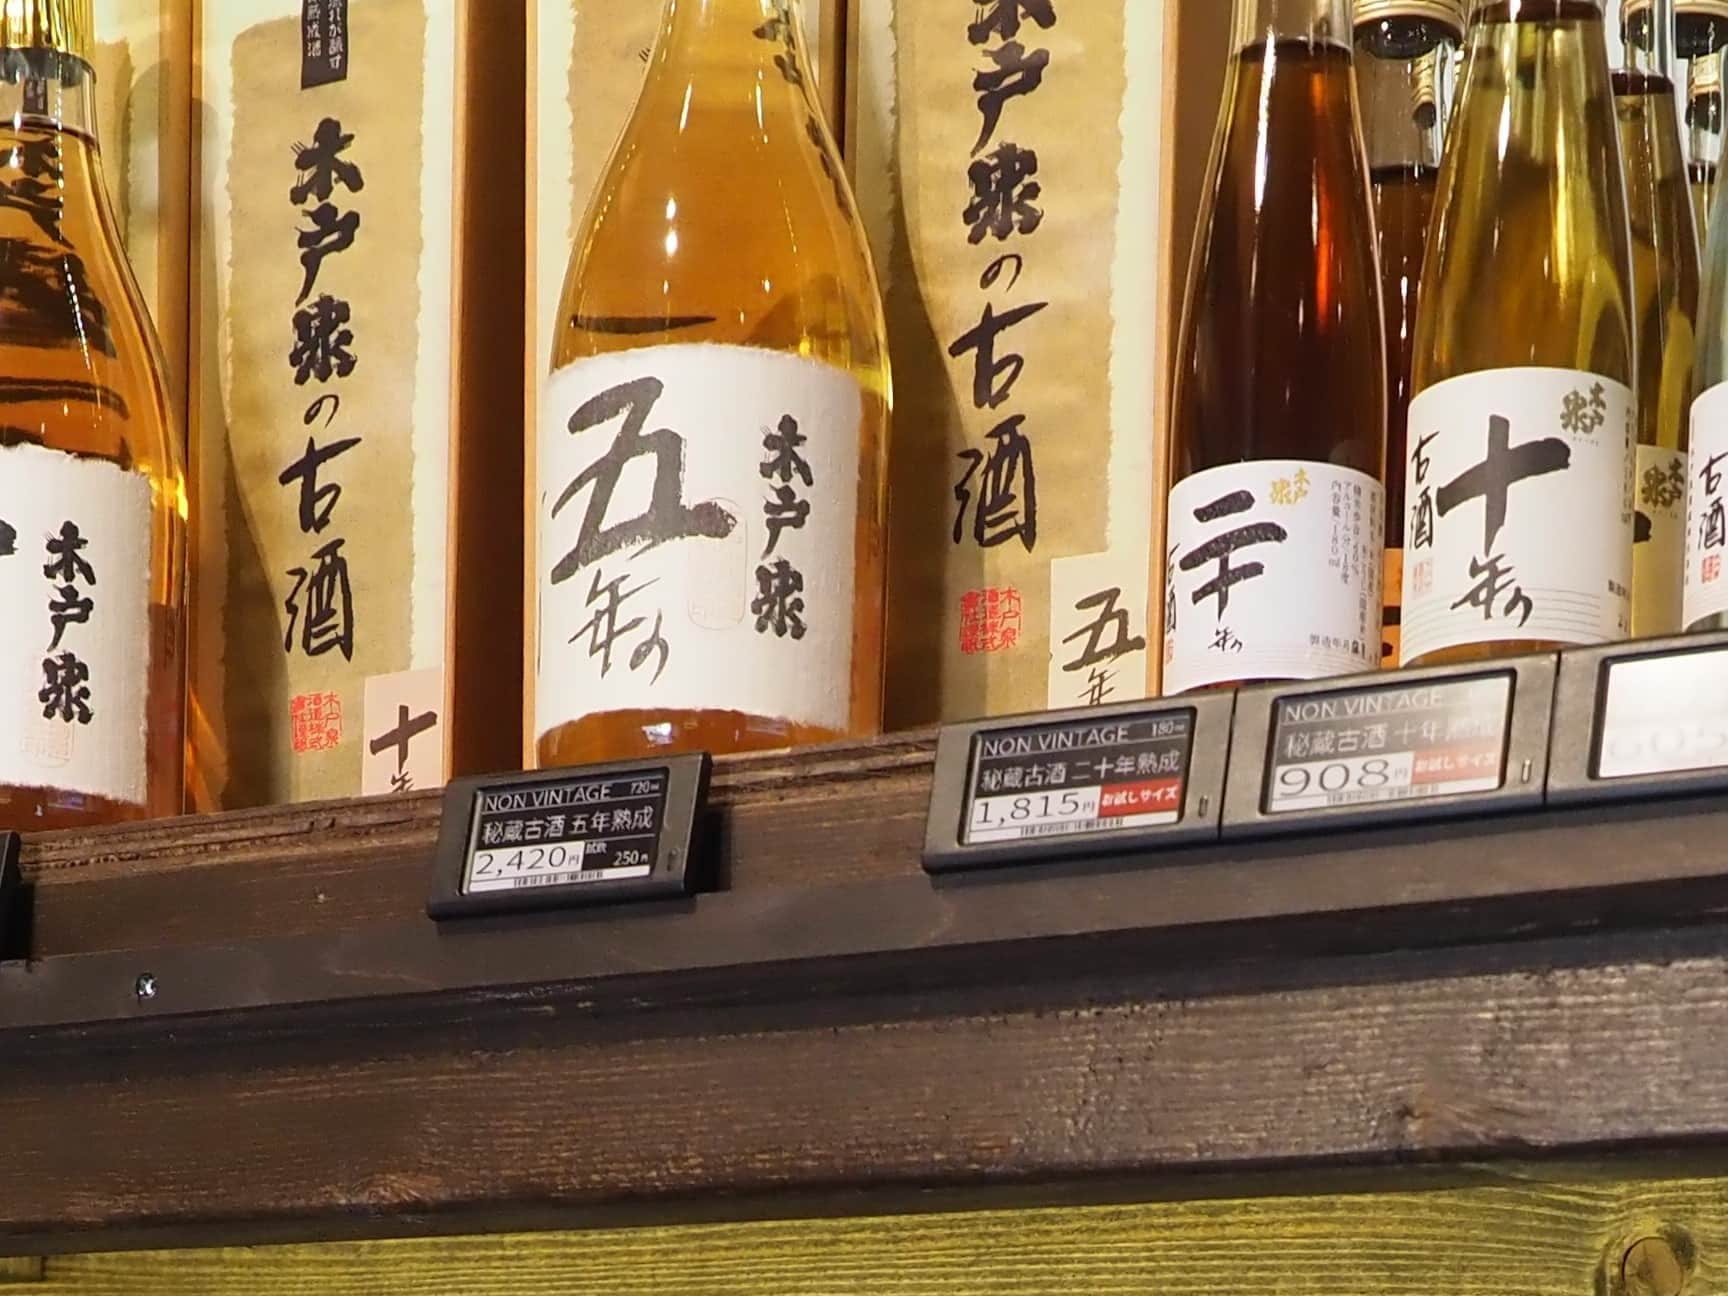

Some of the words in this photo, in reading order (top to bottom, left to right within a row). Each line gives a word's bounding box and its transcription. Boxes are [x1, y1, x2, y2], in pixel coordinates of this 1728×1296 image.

[279, 117, 363, 663] 木戸泉の古酒
[1409, 431, 1439, 550] 古酒
[551, 376, 738, 686] 五年の
[750, 414, 813, 641] 木戸泉
[37, 520, 97, 724] 木戸泉
[1285, 702, 1336, 722] NON
[1343, 690, 1444, 715] VINTAGE
[982, 738, 1031, 757] NON
[1038, 726, 1130, 751] VINTAGE
[1286, 722, 1388, 759] 秘蔵古酒
[981, 762, 1066, 792] 秘蔵古酒
[1071, 749, 1181, 781] 二十年熟成
[1280, 758, 1408, 797] 908円
[485, 794, 527, 812] NON
[531, 783, 612, 806] VINTAGE
[975, 791, 1095, 827] 1,815円
[481, 814, 565, 845] 秘蔵古酒
[571, 804, 653, 835] 五年熟成
[475, 845, 579, 877] 2,420円
